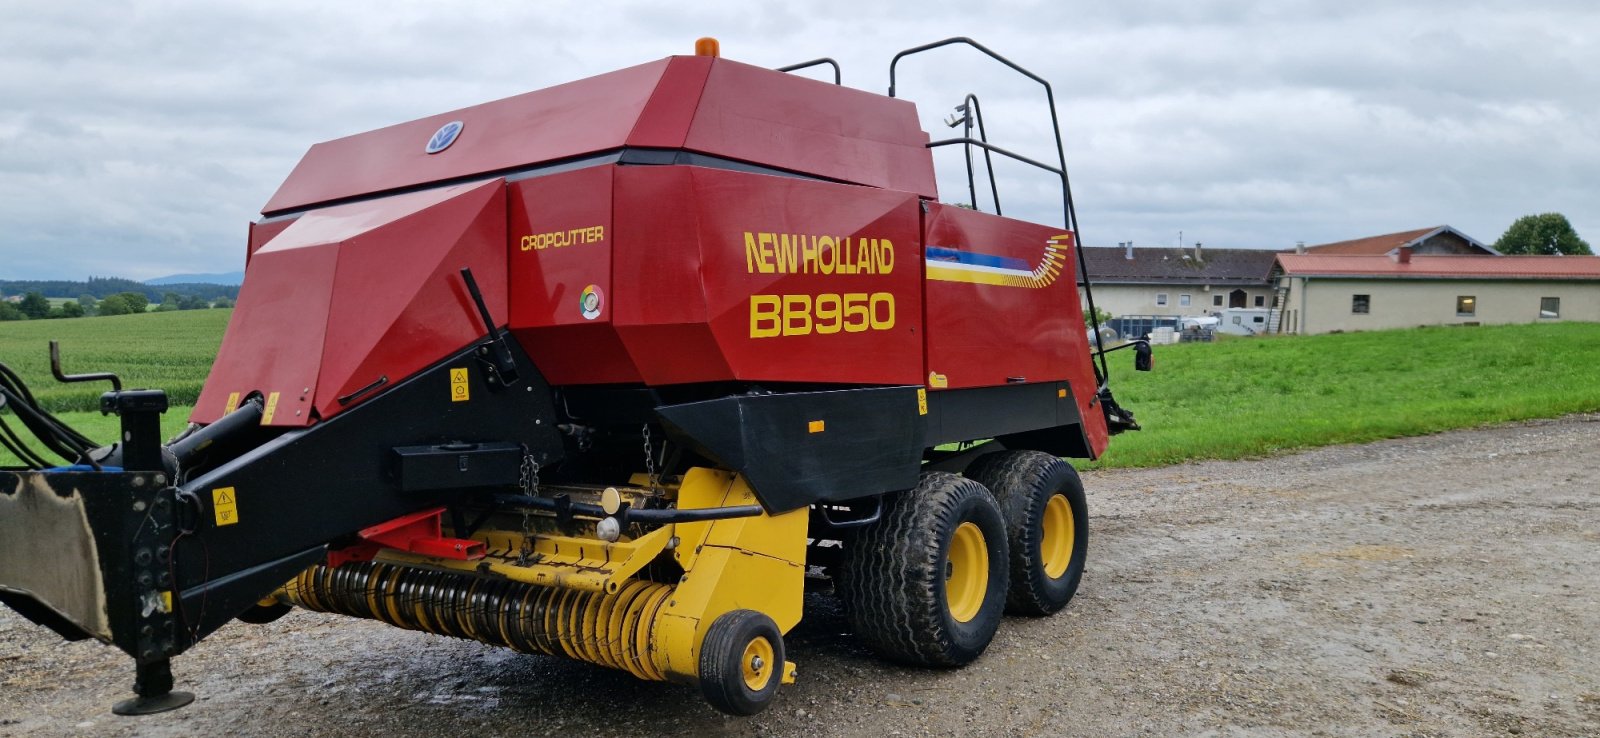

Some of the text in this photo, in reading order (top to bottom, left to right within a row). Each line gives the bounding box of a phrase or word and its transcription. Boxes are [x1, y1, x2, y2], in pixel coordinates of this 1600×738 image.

[521, 226, 604, 251] CROPCUTTER
[744, 232, 895, 275] NEW HOLLAND
[749, 293, 896, 339] BB950
